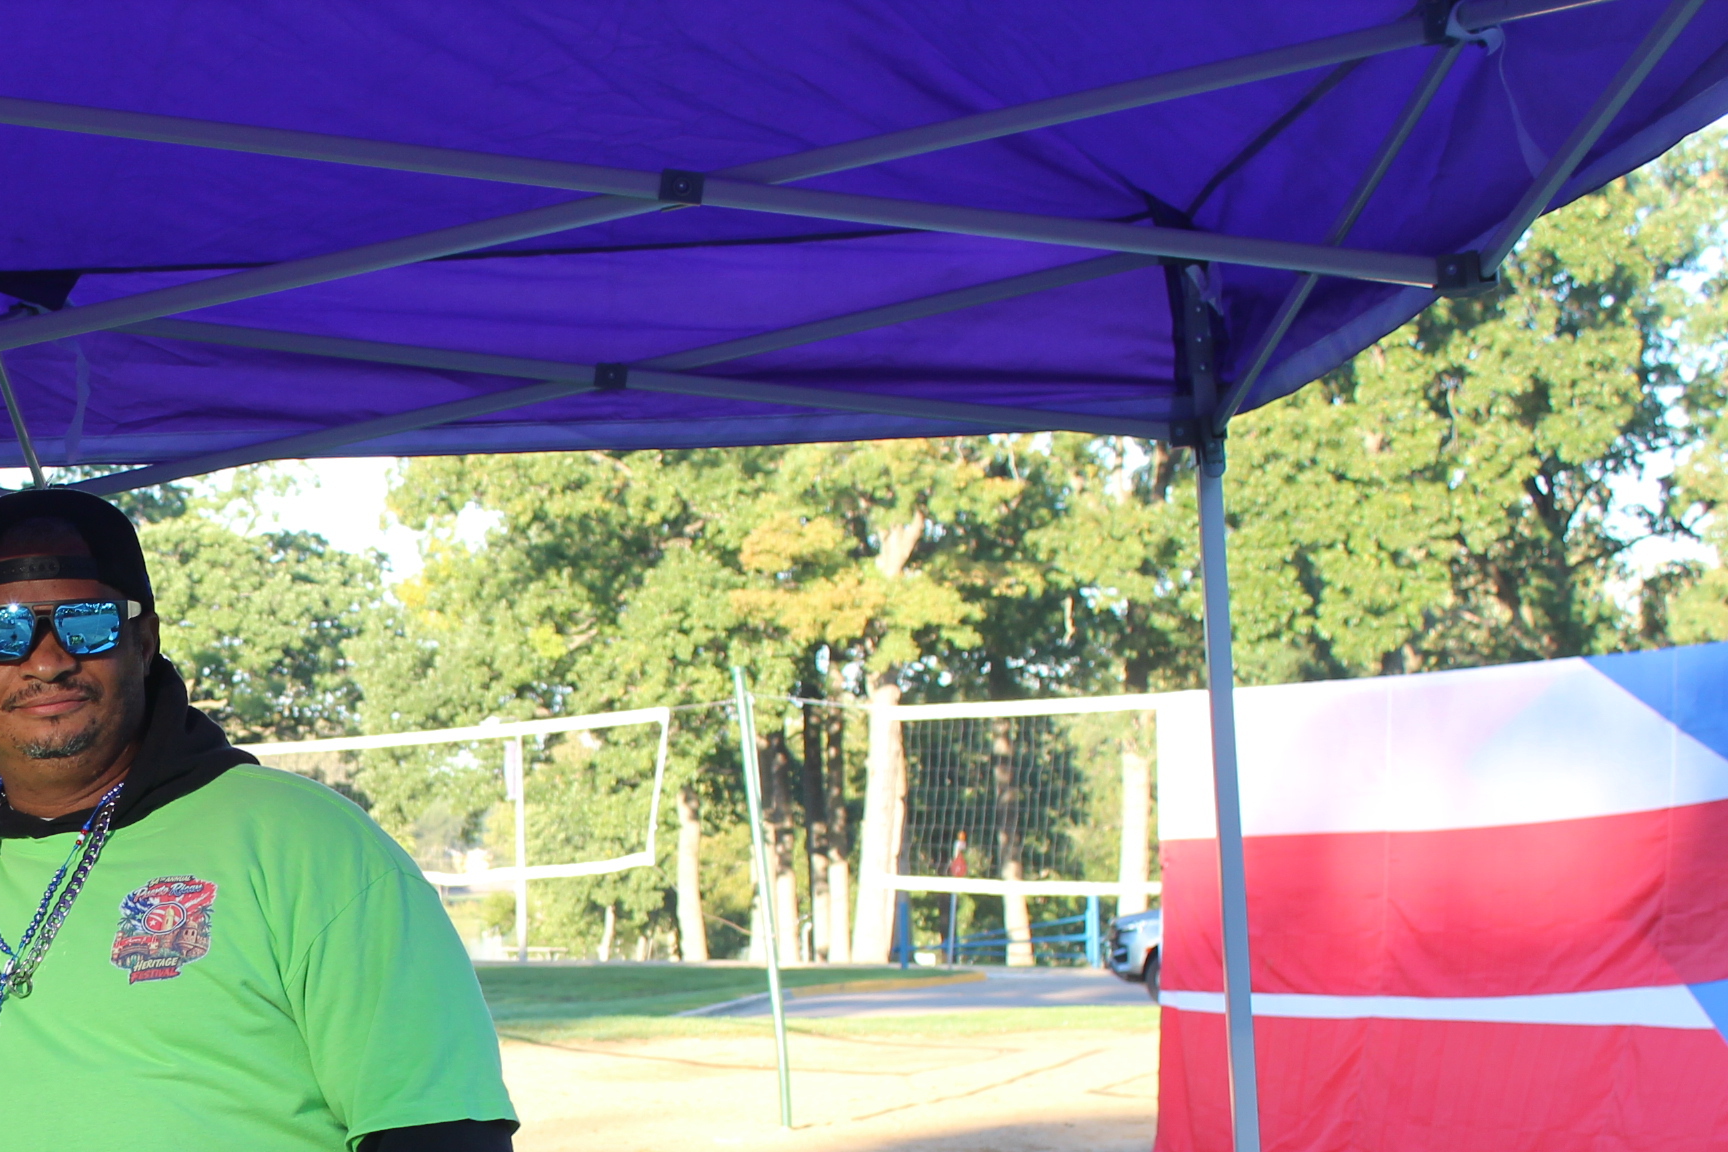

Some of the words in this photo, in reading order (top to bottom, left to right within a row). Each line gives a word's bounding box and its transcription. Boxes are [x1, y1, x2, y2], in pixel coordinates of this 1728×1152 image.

[133, 884, 170, 902] Puerto
[169, 882, 203, 896] Rican
[133, 957, 179, 971] HERITAGE
[131, 967, 177, 982] FESTIVAL
